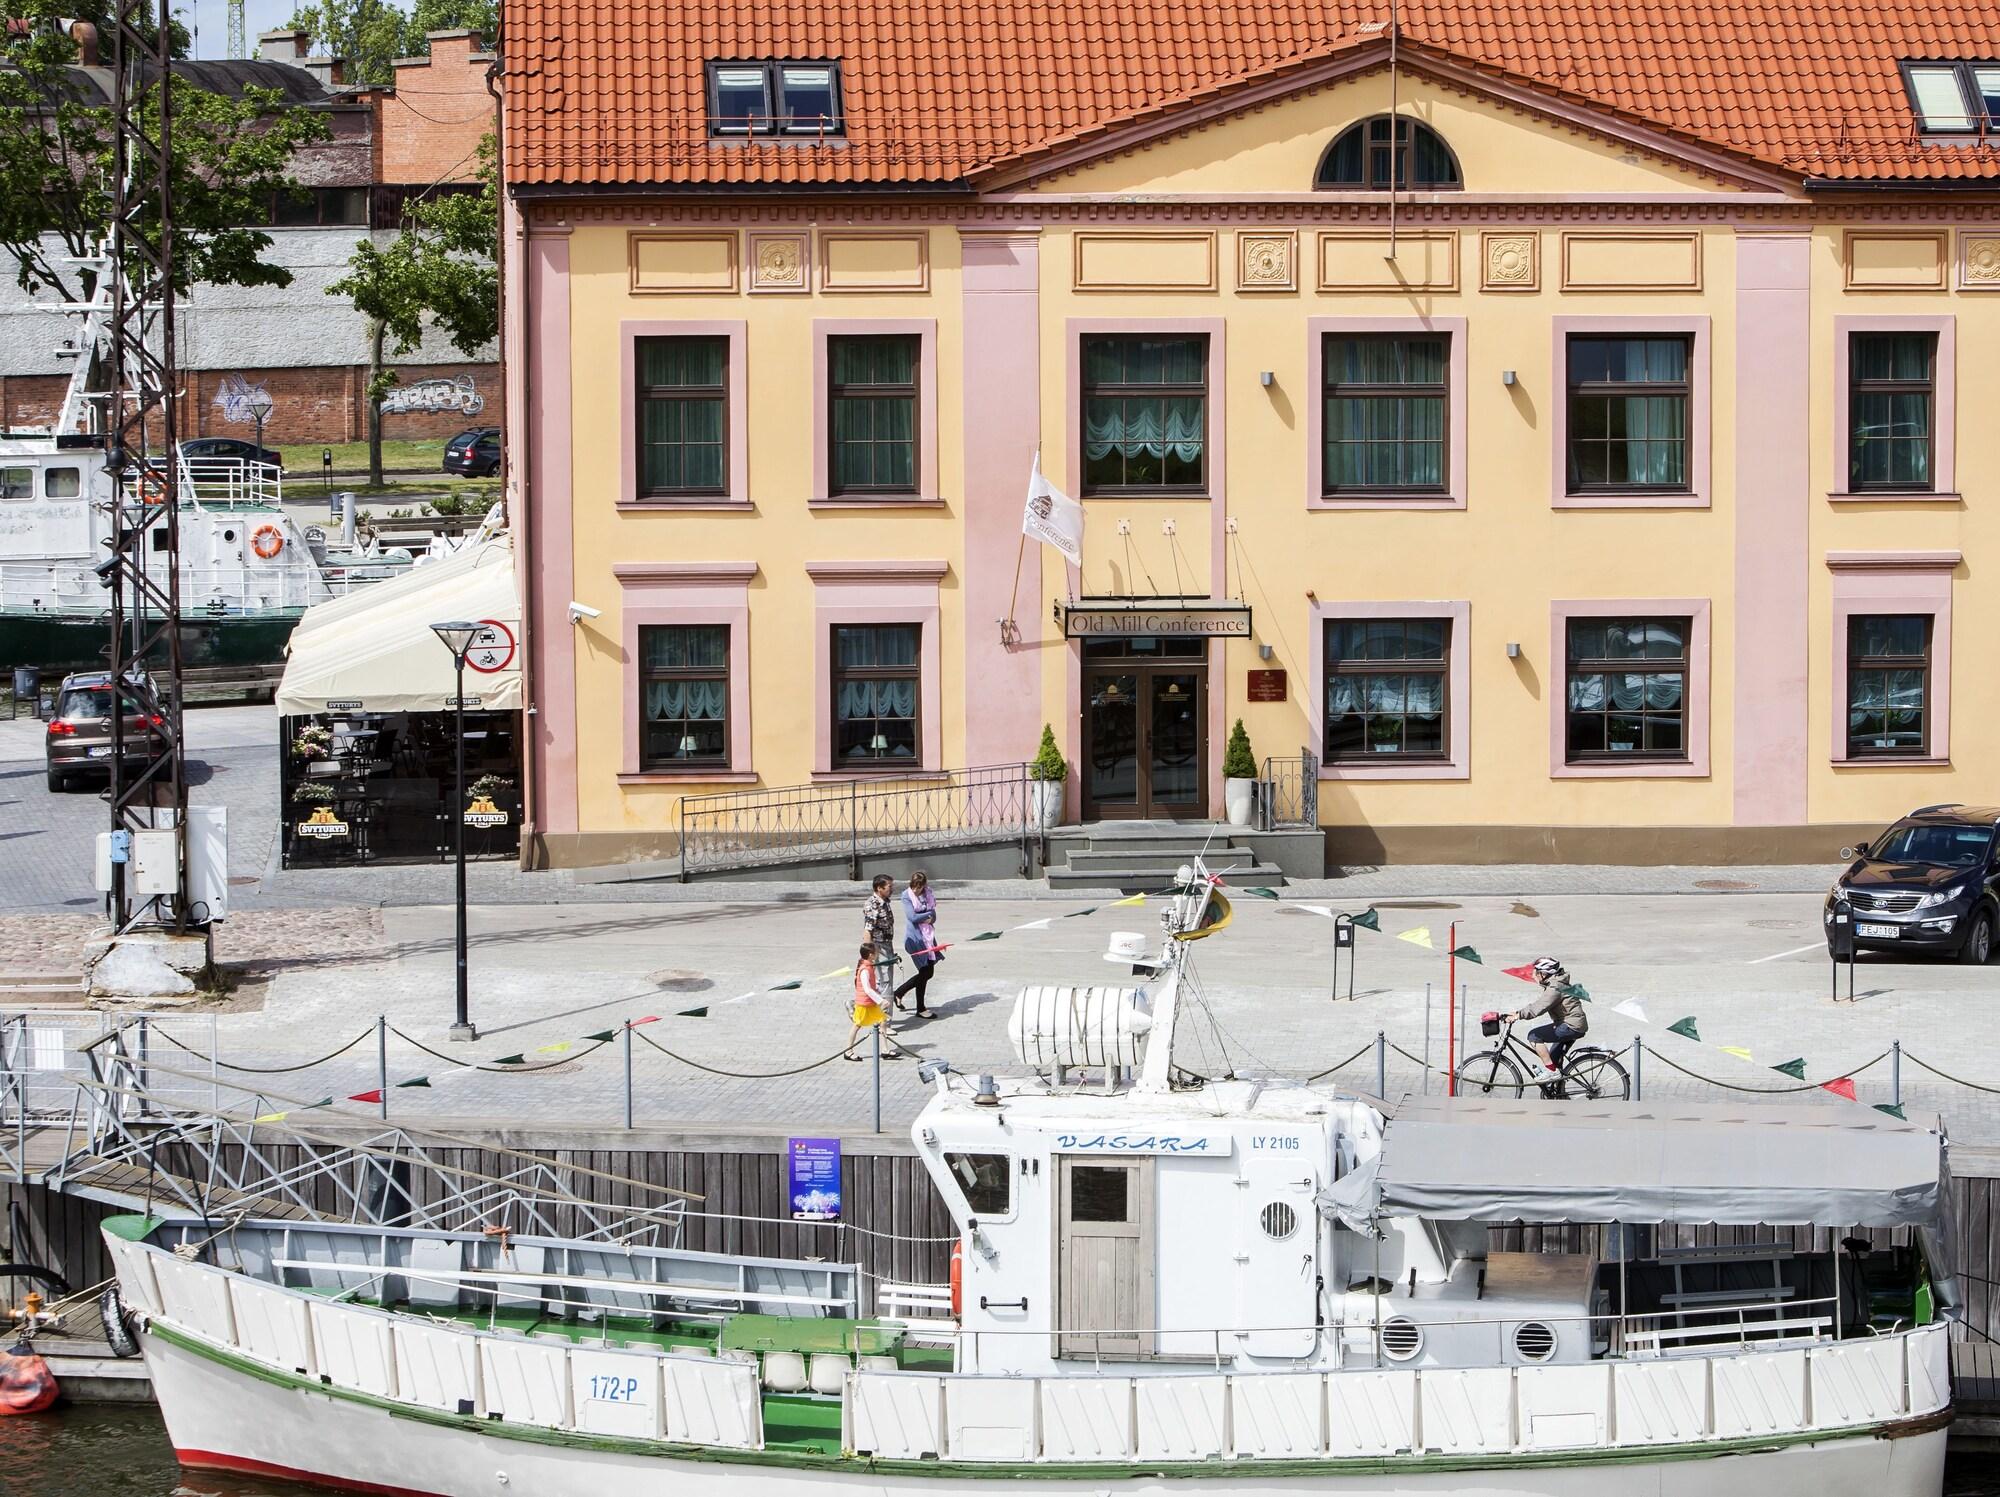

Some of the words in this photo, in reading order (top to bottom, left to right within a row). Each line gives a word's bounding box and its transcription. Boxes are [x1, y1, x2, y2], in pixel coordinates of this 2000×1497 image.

[1072, 615, 1103, 632] Old
[1109, 615, 1141, 632] Mill
[1146, 615, 1245, 632] Conference
[1861, 925, 1878, 934] FEJ
[1884, 927, 1898, 935] 105
[1057, 1135, 1209, 1152] VASARA
[1253, 1137, 1268, 1149] LY
[1270, 1137, 1299, 1150] 2105
[591, 1375, 637, 1401] 172-P
